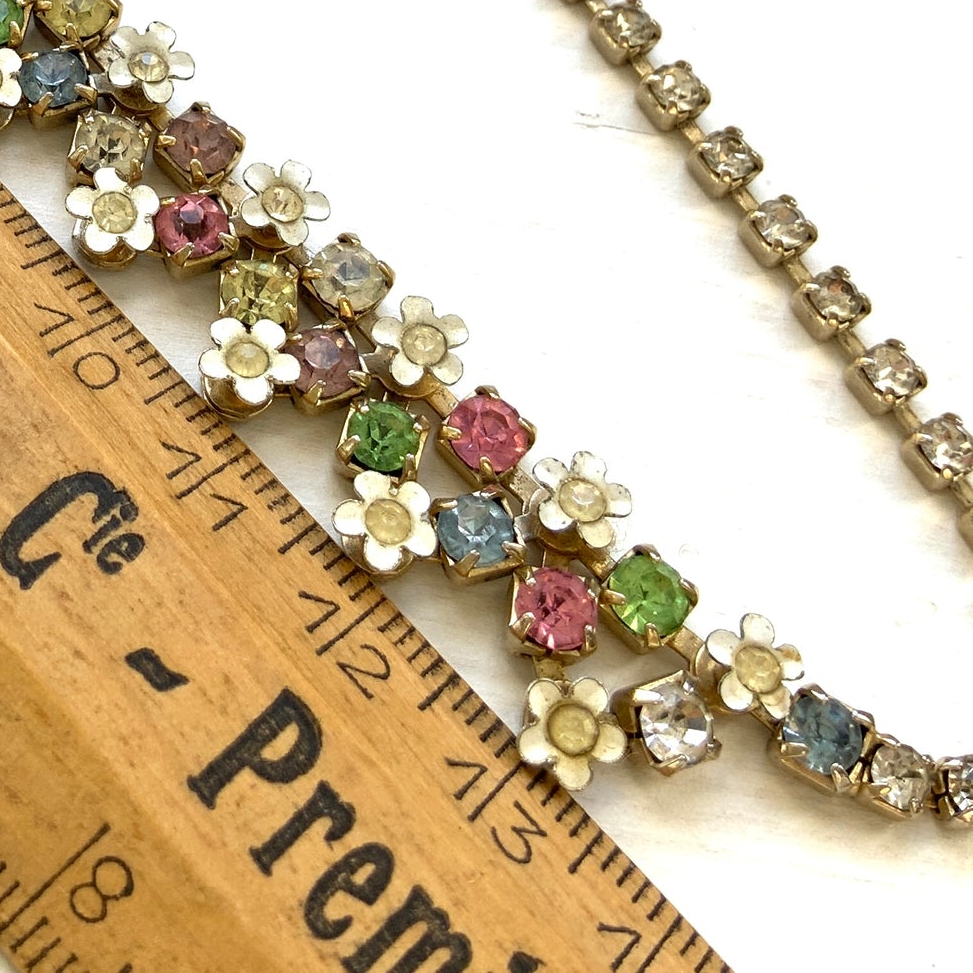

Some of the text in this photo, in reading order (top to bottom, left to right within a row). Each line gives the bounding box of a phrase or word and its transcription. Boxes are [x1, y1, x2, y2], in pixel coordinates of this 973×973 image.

[33, 301, 122, 390] 10
[158, 438, 249, 532] 11
[298, 589, 392, 700] 12
[445, 754, 552, 866] 13
[69, 855, 135, 924] 8
